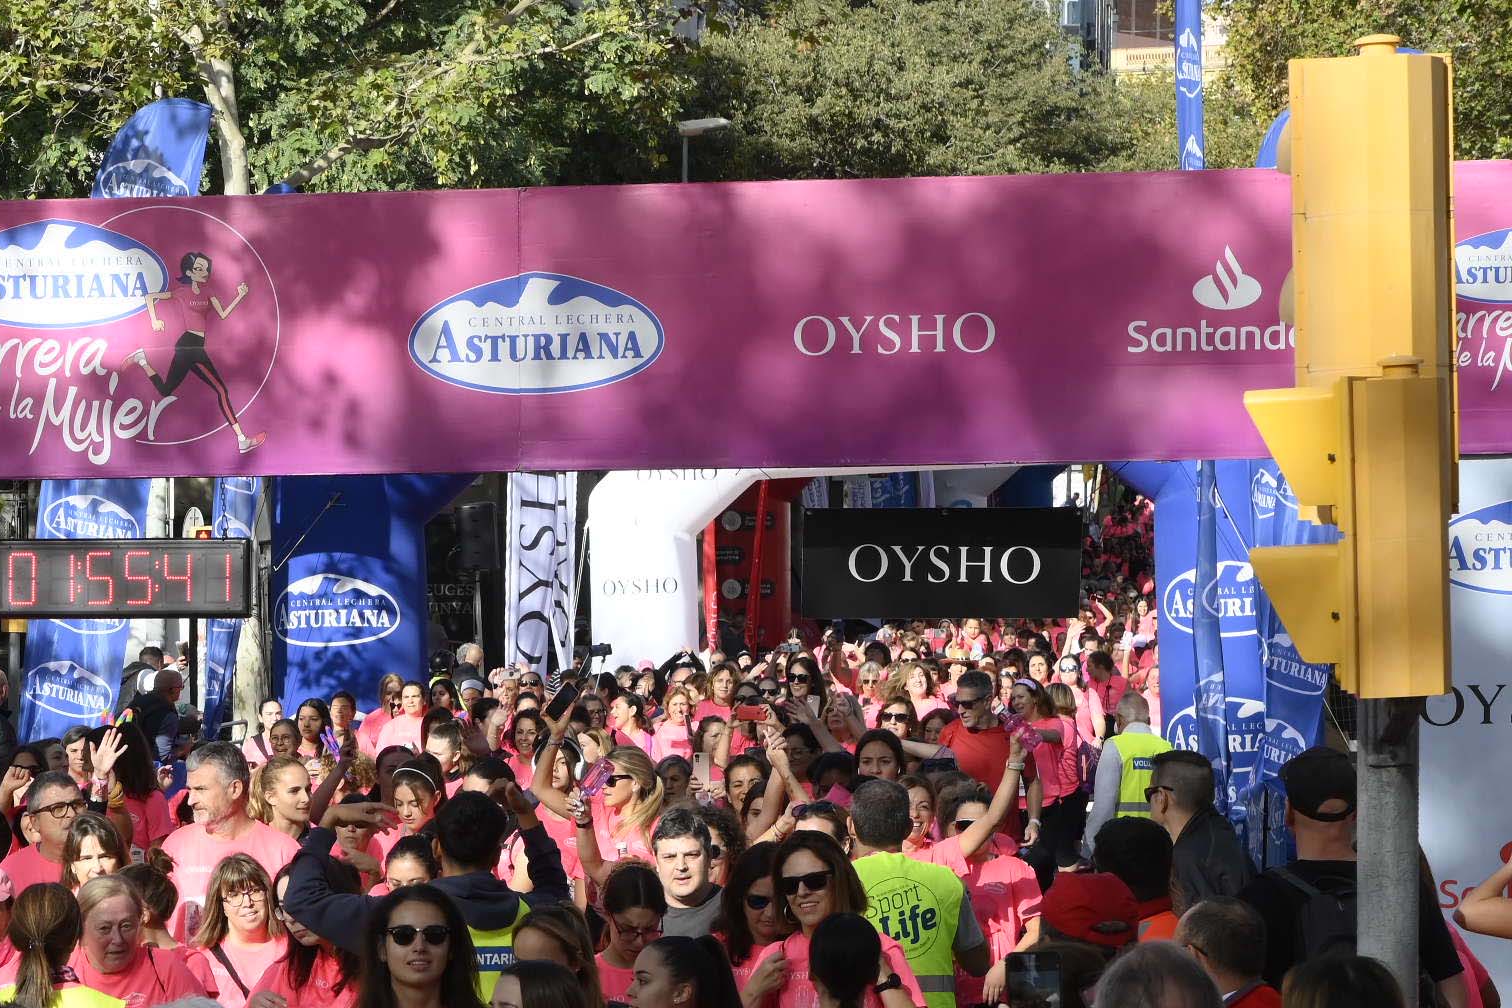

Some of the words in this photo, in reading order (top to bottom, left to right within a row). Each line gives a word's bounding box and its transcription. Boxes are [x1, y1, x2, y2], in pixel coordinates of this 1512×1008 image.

[468, 314, 547, 328] CENTRAL
[555, 313, 636, 327] LECHERA
[794, 312, 996, 356] OYSHO
[1127, 319, 1296, 354] Santand
[428, 319, 645, 364] ASTURIANA
[9, 377, 34, 420] la
[28, 370, 178, 465] Mujer
[7, 549, 232, 606] 01:55:41
[847, 543, 1042, 585] OYSHO
[290, 598, 333, 607] CENTRAL
[337, 597, 387, 607] LECHERA
[602, 576, 678, 597] OYSHO
[278, 606, 391, 631] ASTURIANA
[28, 673, 105, 710] ASTURIANA
[1421, 684, 1512, 727] OY
[865, 883, 923, 919] Sport
[879, 904, 937, 944] Life
